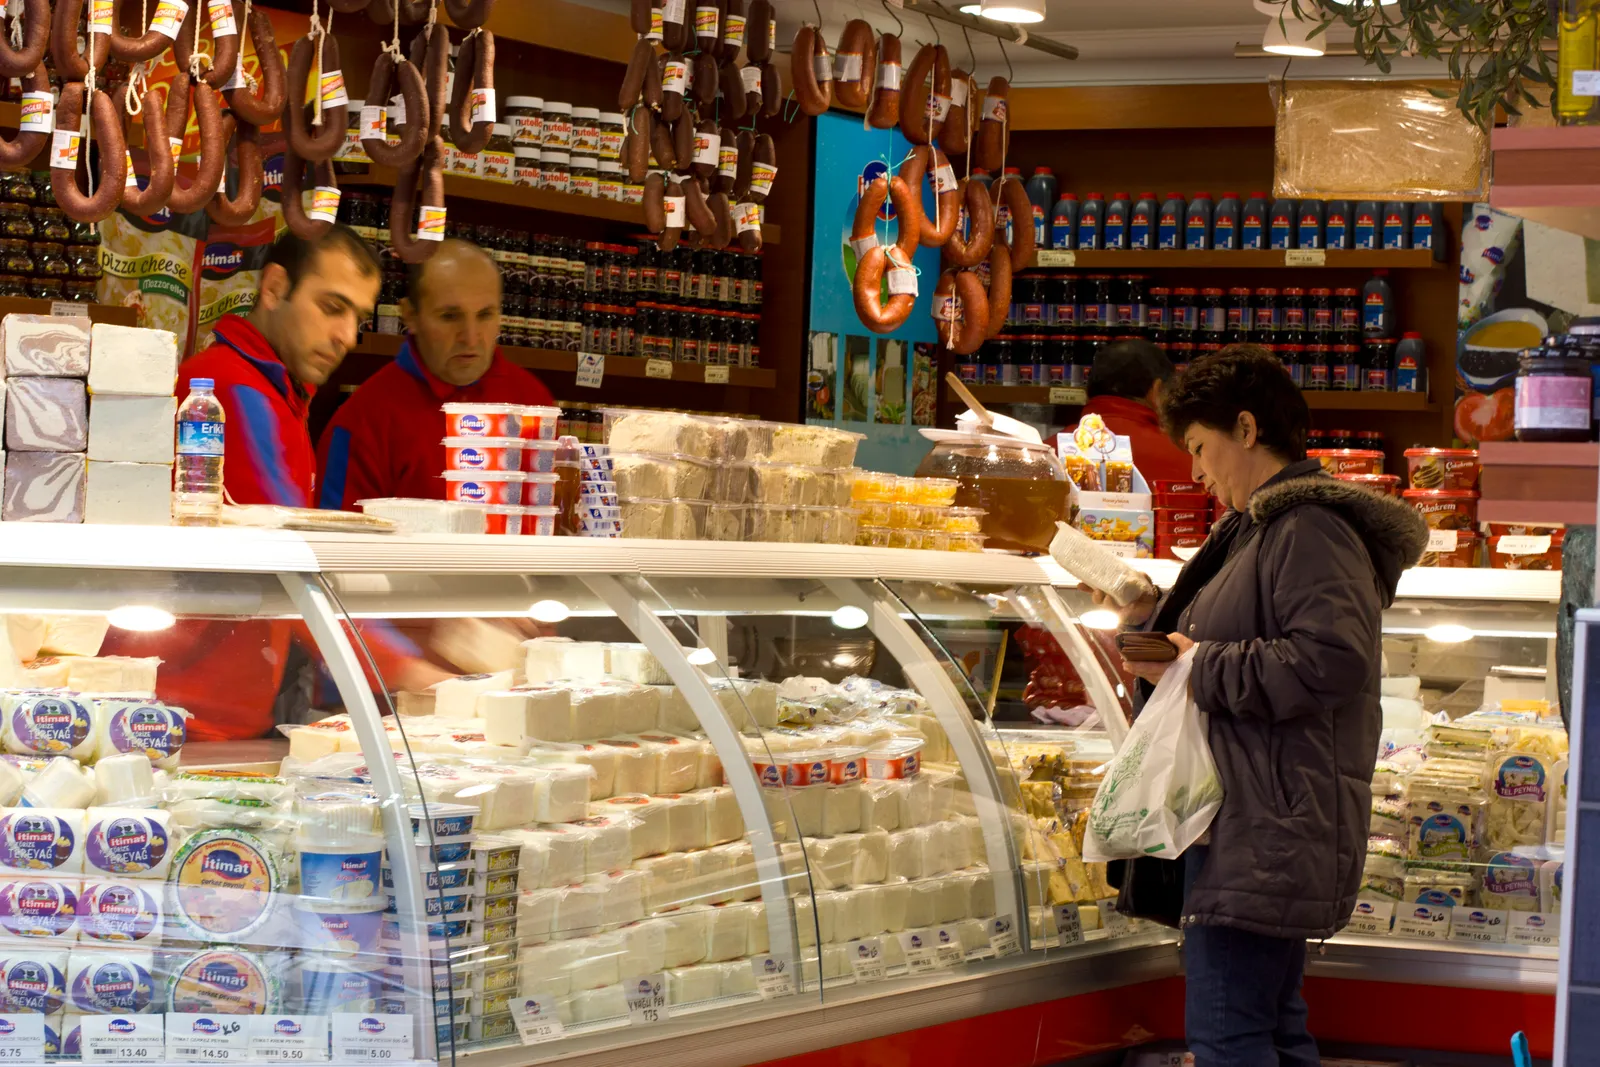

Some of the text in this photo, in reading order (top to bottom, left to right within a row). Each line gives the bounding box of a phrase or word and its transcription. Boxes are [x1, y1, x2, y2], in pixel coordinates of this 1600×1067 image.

[515, 118, 542, 128] nutella
[543, 123, 572, 133] nutella
[572, 127, 600, 137] nutella
[514, 168, 541, 178] nutella
[541, 172, 569, 183] nutella
[201, 252, 242, 266] itimat
[101, 251, 187, 279] pizza cheese
[461, 419, 485, 428] itimat
[460, 453, 484, 461] itimat
[461, 487, 485, 495] itimat
[36, 715, 70, 723] itimat
[133, 723, 167, 731] itimat
[436, 821, 461, 836] beyaz
[17, 833, 53, 841] itimat
[111, 835, 146, 846] itimat
[204, 857, 250, 874] itimat
[342, 861, 367, 869] itimat
[22, 900, 57, 909] itimat
[102, 904, 138, 914] itimat
[201, 969, 246, 987] itimat
[10, 980, 46, 990] itimat
[95, 982, 132, 992] itimat
[109, 1022, 136, 1030] itimat
[194, 1022, 220, 1031] itimat
[275, 1023, 301, 1031] itimat
[360, 1022, 385, 1030] itimat
[120, 1048, 147, 1057] 13.40
[202, 1050, 229, 1058] 14.50
[282, 1050, 303, 1058] 9.50
[370, 1049, 391, 1058] 5.00
